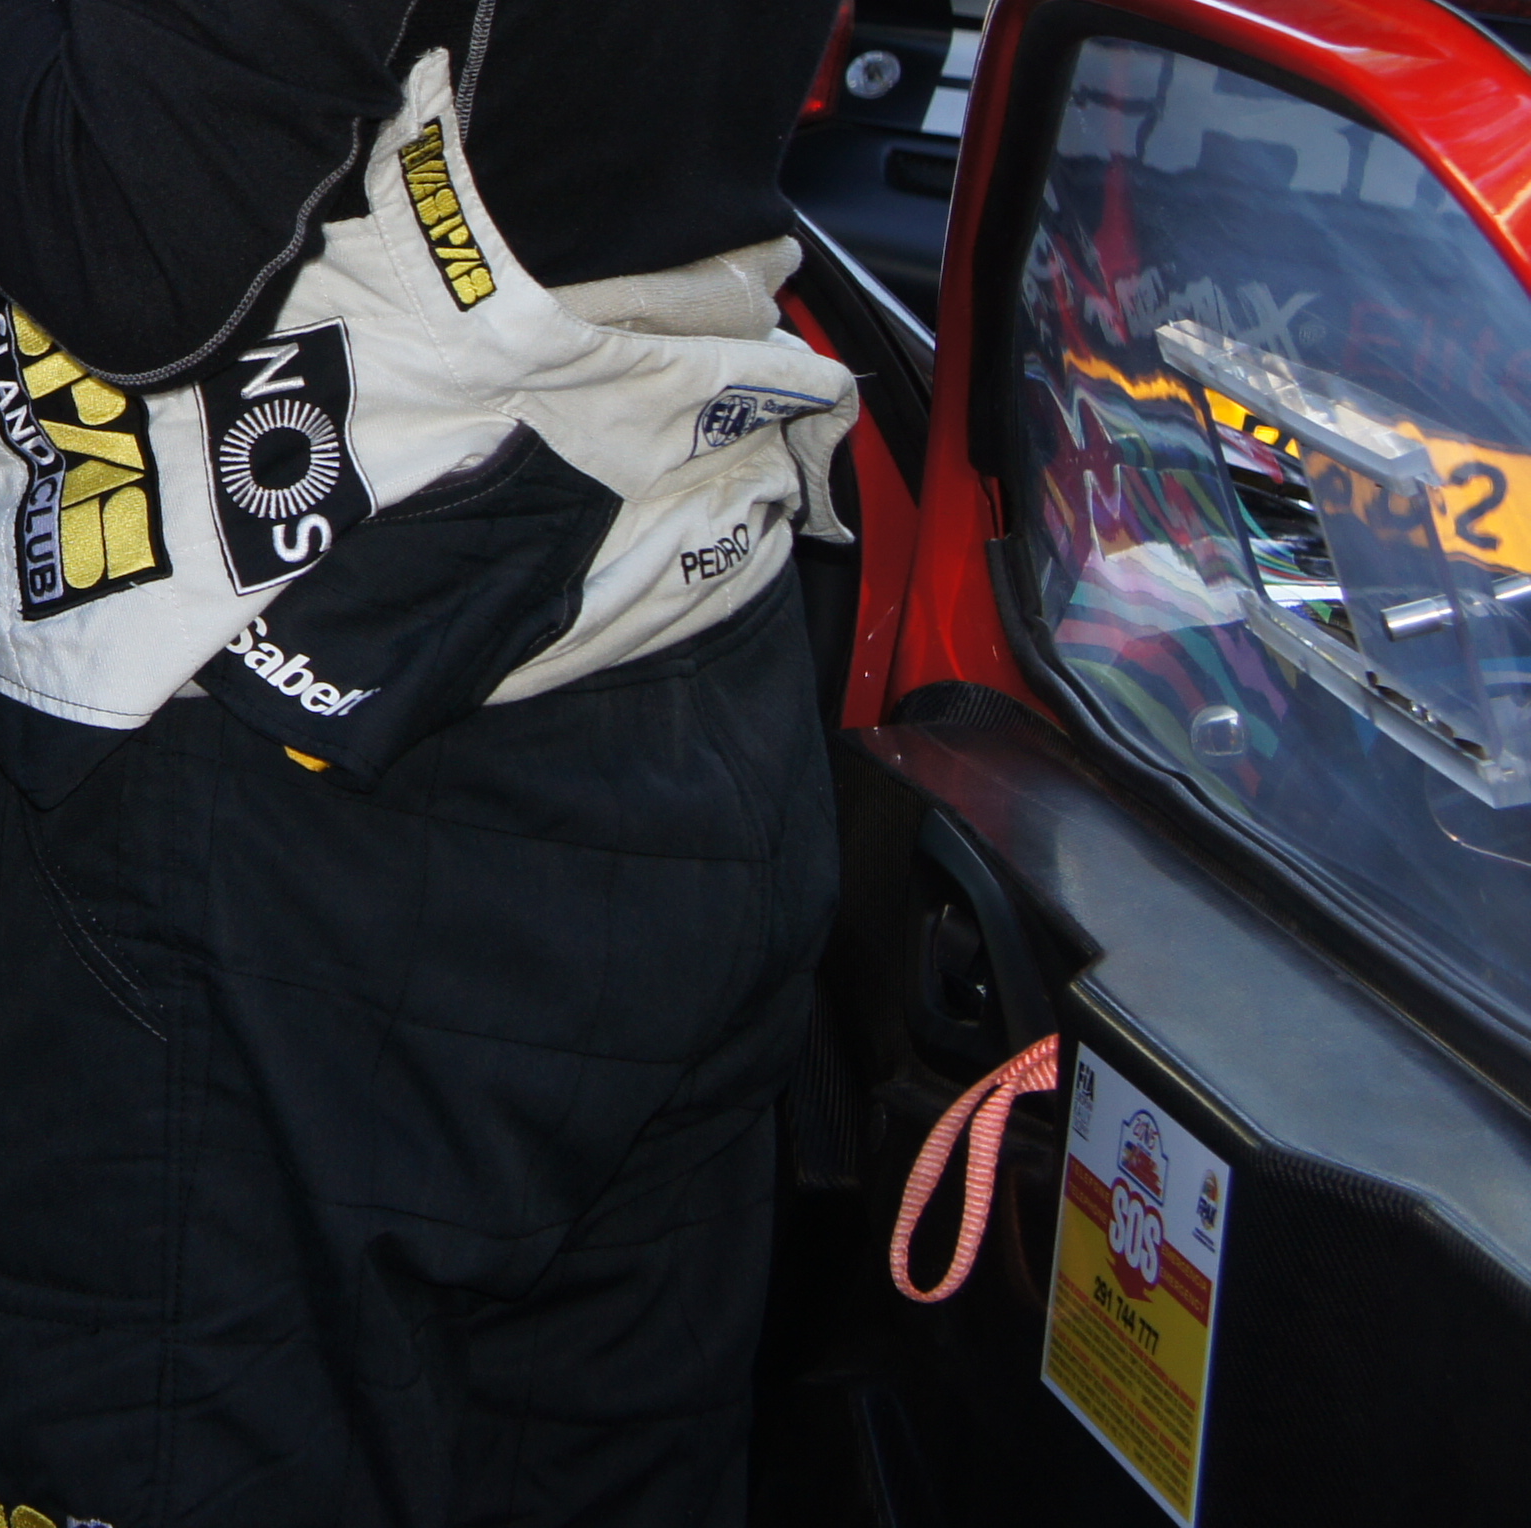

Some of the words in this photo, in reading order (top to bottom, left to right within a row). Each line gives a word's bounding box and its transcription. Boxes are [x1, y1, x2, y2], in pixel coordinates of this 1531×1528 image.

[22, 475, 64, 602] CLUB
[680, 524, 750, 587] PEDRO
[1108, 1183, 1163, 1286] SOS
[1134, 1317, 1160, 1357] 777
